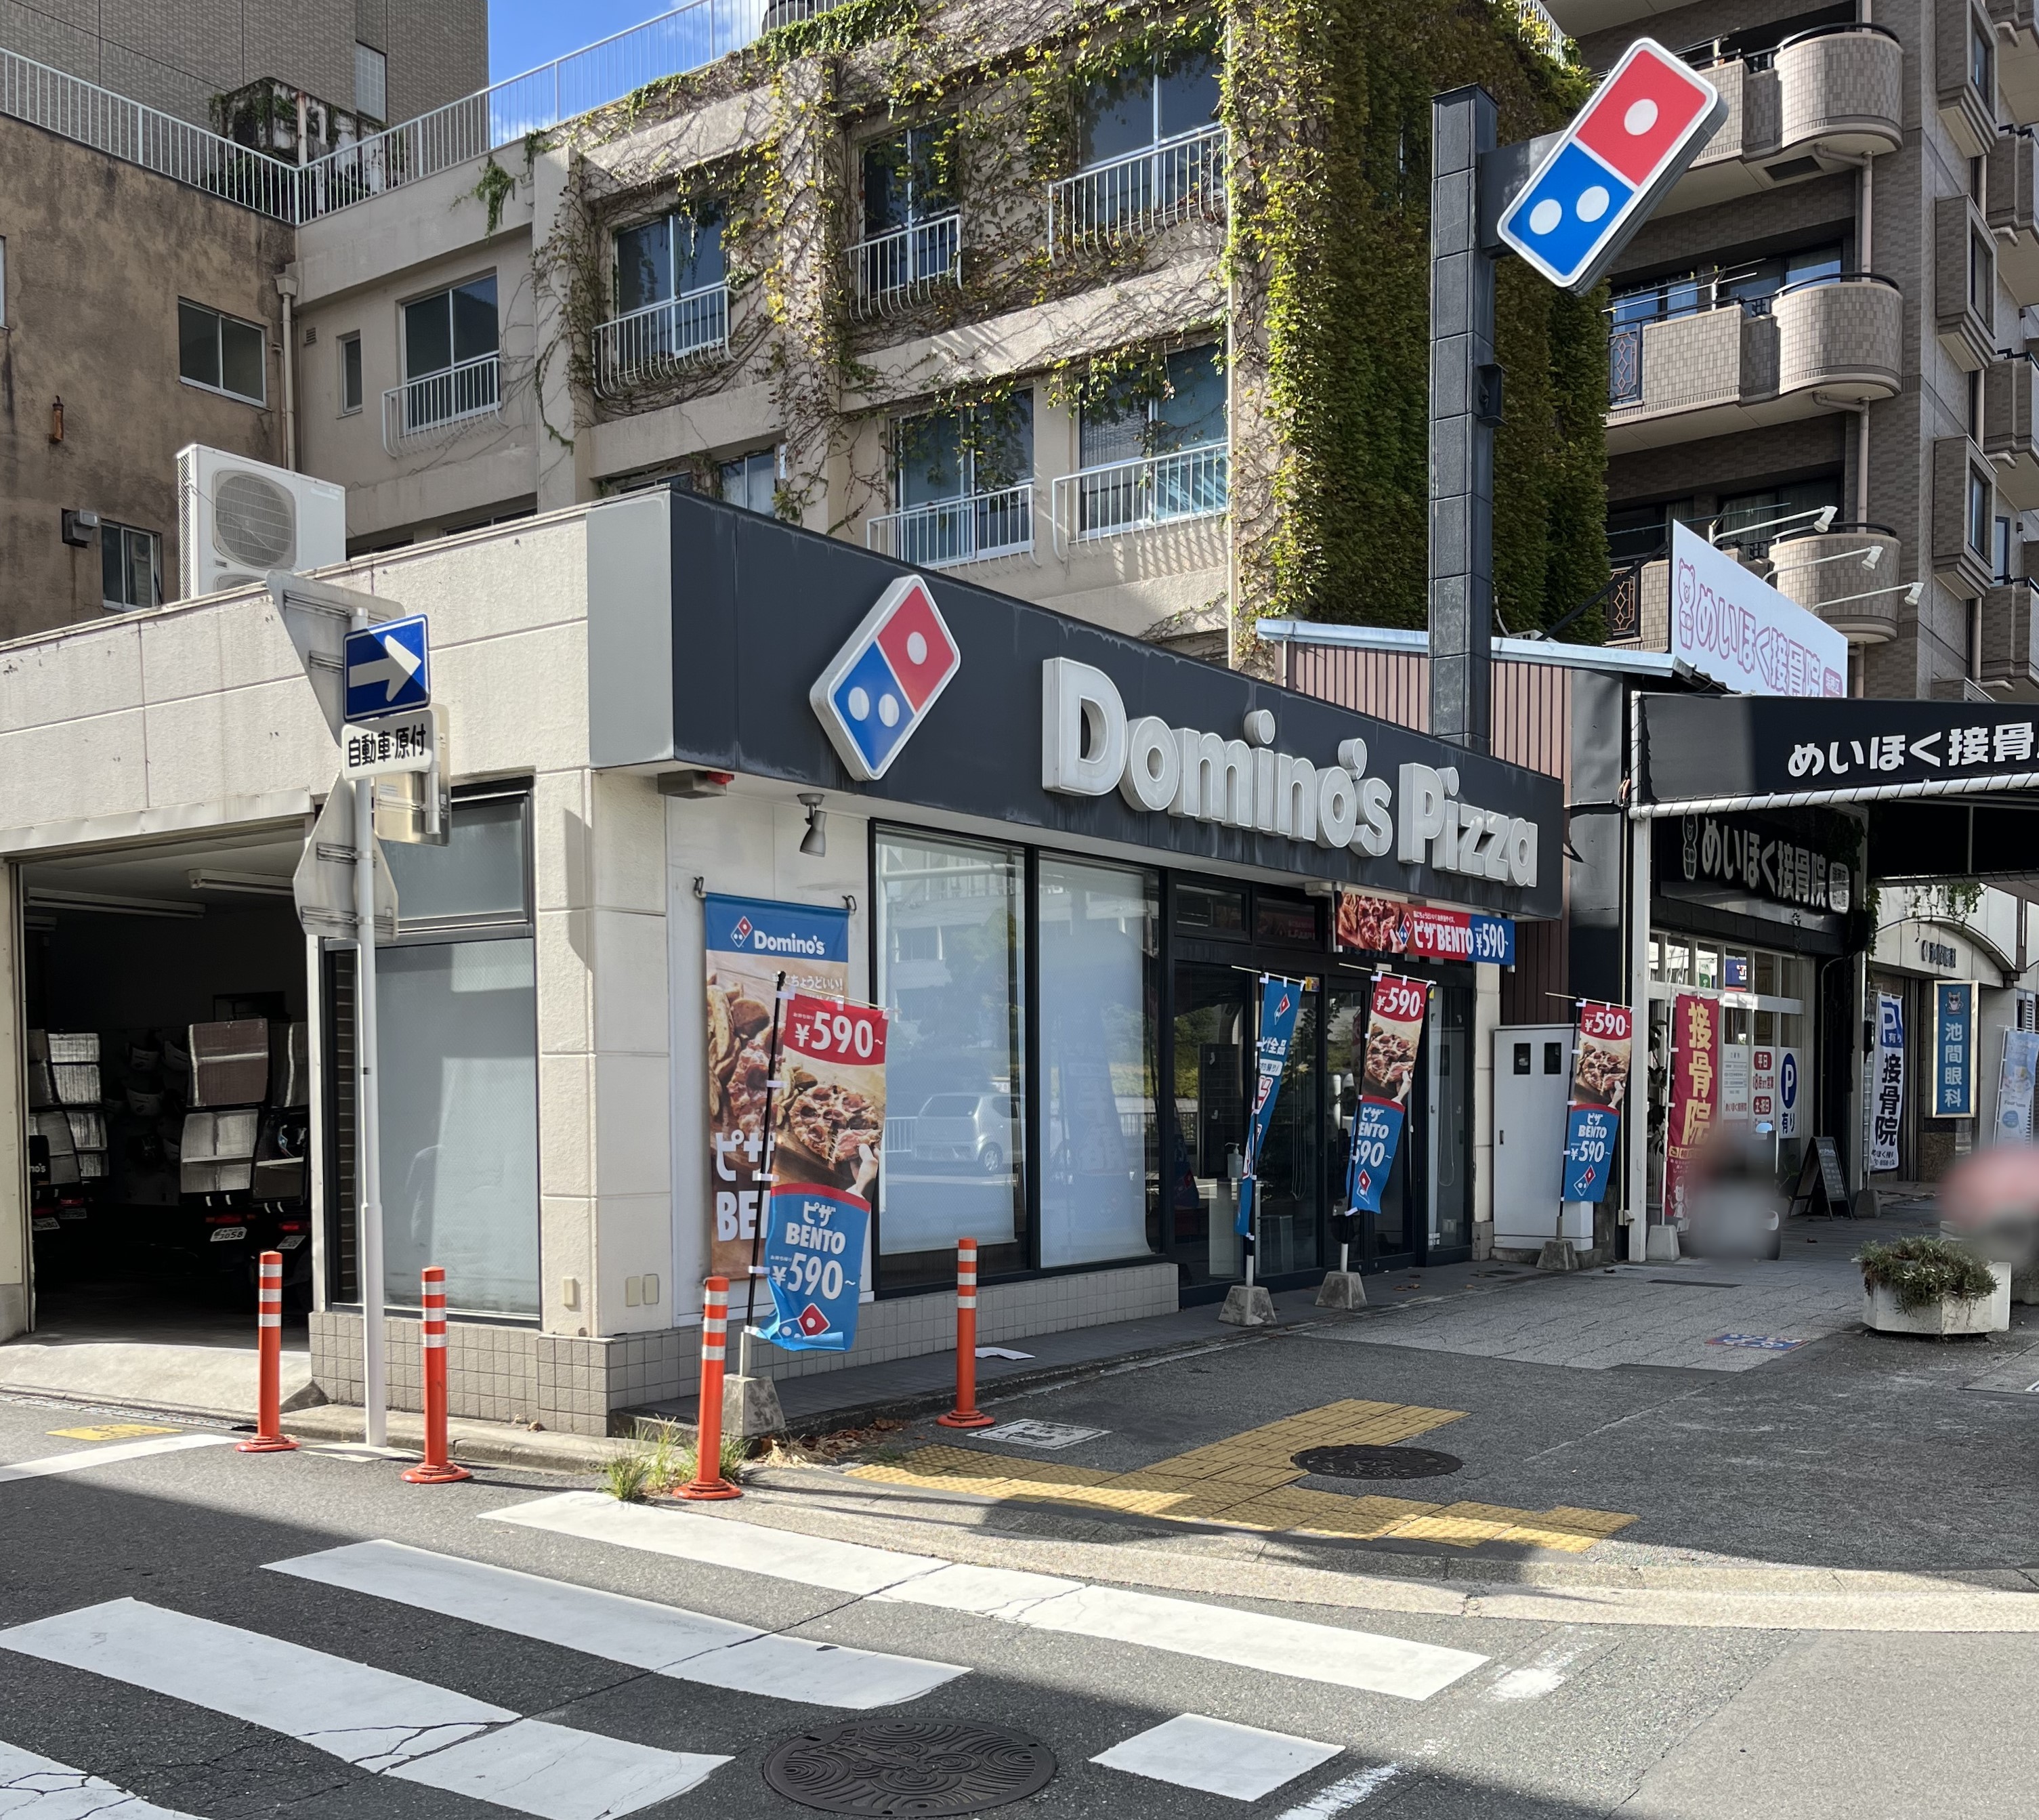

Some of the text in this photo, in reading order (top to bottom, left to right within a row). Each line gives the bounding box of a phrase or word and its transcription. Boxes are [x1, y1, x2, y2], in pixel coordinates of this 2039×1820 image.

[1787, 721, 2039, 778] めいほく接骨
[1043, 657, 1538, 887] Domino's Pizza
[1701, 815, 1827, 909] めいほく接骨院
[754, 930, 826, 955] Domino's
[1681, 1000, 1713, 1145] 接骨院
[1944, 1022, 1963, 1107] 池間眼科
[1785, 1063, 1794, 1101] P
[1362, 1107, 1385, 1122] ピザ
[1875, 1053, 1901, 1147] 接骨院
[1357, 1122, 1389, 1139] ENTO
[1578, 1125, 1607, 1139] BENTO
[1586, 1113, 1603, 1126] ピザ
[1781, 1112, 1795, 1135] 有り
[803, 1201, 837, 1227] ピザ
[785, 1222, 846, 1255] BENTO
